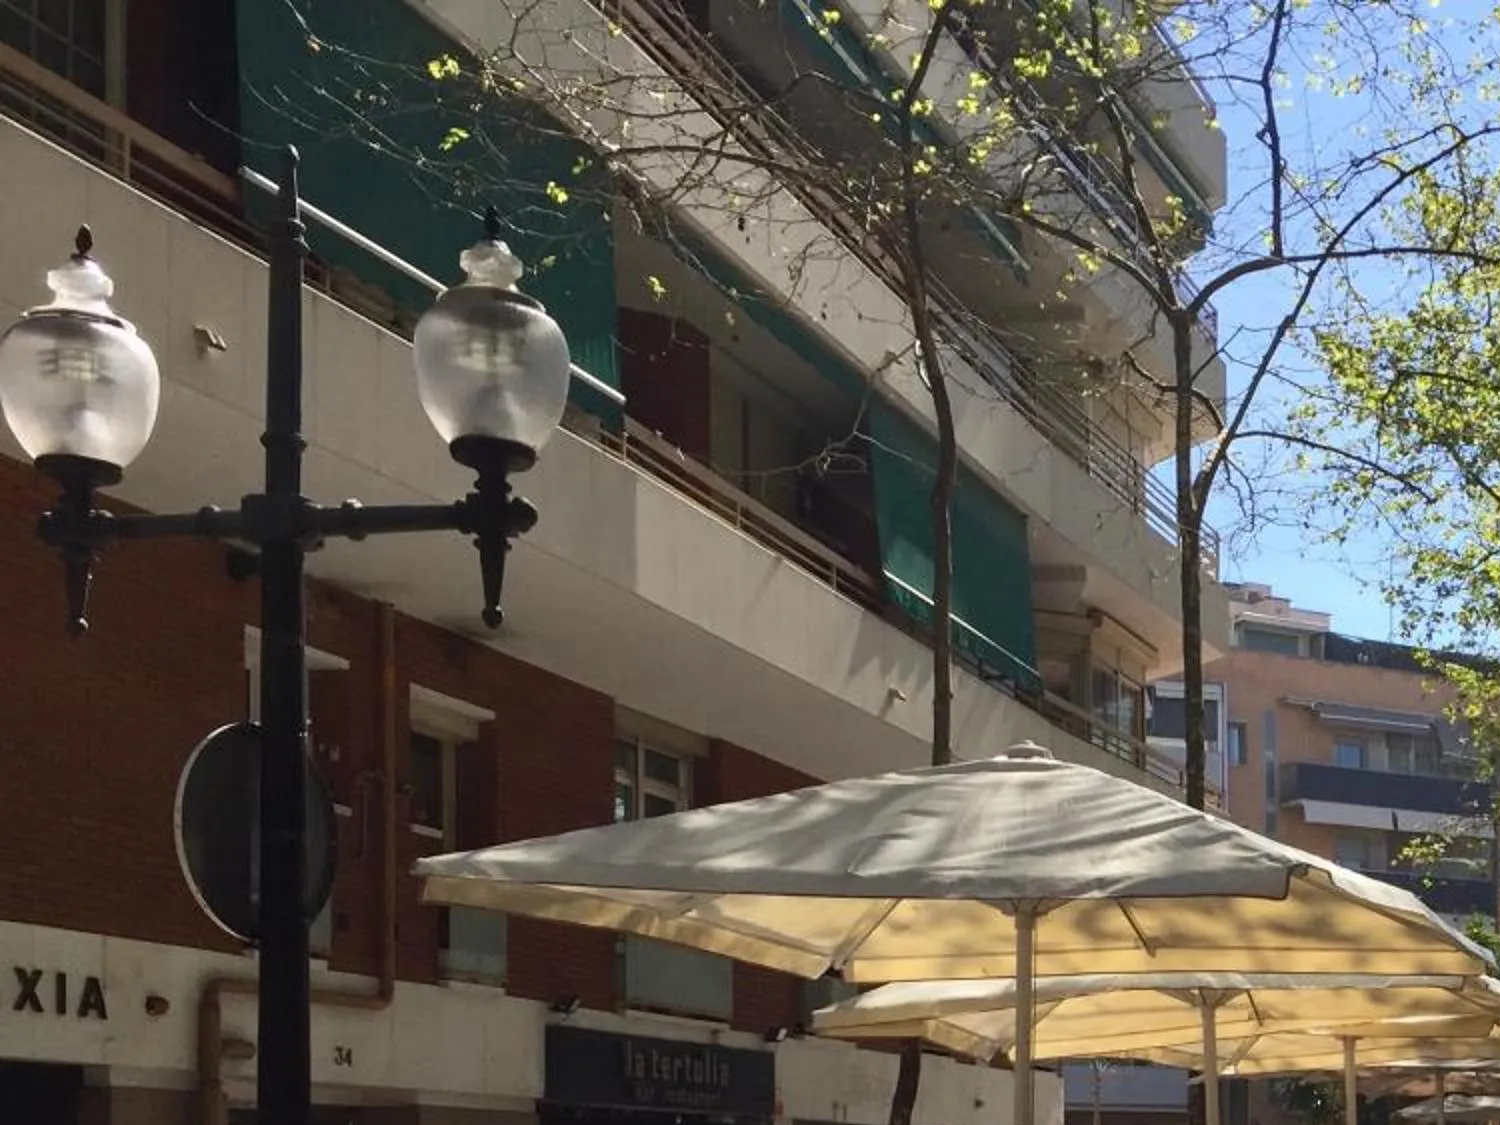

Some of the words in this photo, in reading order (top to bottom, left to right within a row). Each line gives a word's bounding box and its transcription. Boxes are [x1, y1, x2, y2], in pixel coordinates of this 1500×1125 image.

[12, 966, 108, 1020] XIA
[334, 1045, 352, 1067] 34
[624, 1039, 645, 1078] la
